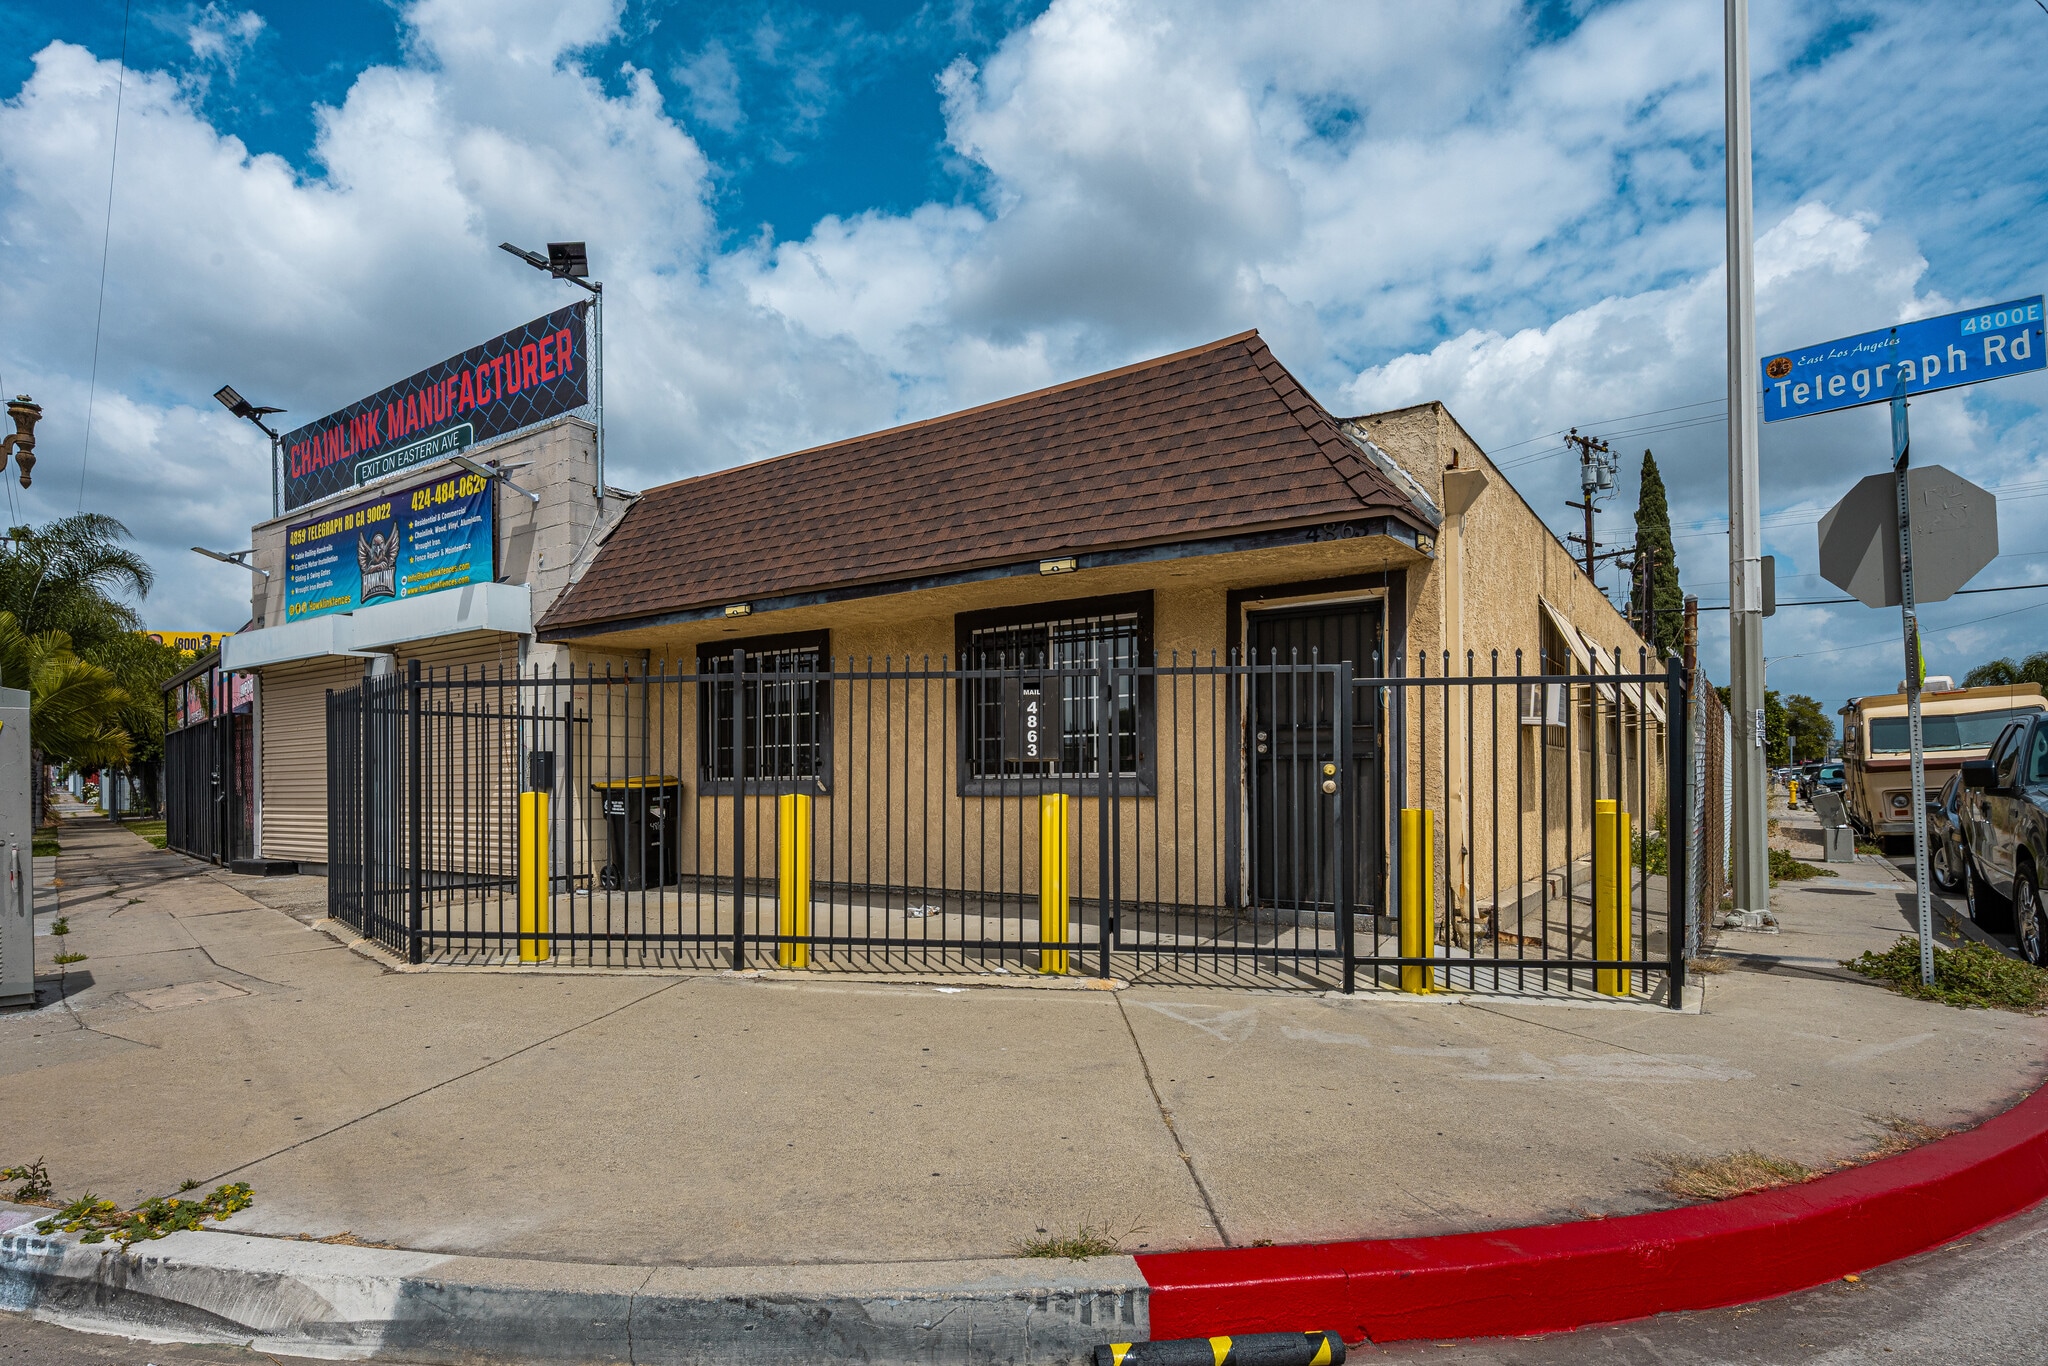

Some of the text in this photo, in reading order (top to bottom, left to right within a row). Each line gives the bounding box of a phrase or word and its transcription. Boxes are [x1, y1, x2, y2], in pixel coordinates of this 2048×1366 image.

[1964, 304, 2039, 333] 4800E
[1774, 328, 2032, 409] Telegraph Rd
[1797, 337, 1901, 366] East Los Angeles
[291, 328, 573, 479] CHAINLINK MANUFACTURER
[362, 430, 460, 479] EXIT ON EASTERN AVE
[290, 502, 391, 546] 4859 TELEGRAPH RD CA 90022
[1027, 702, 1038, 756] 4863
